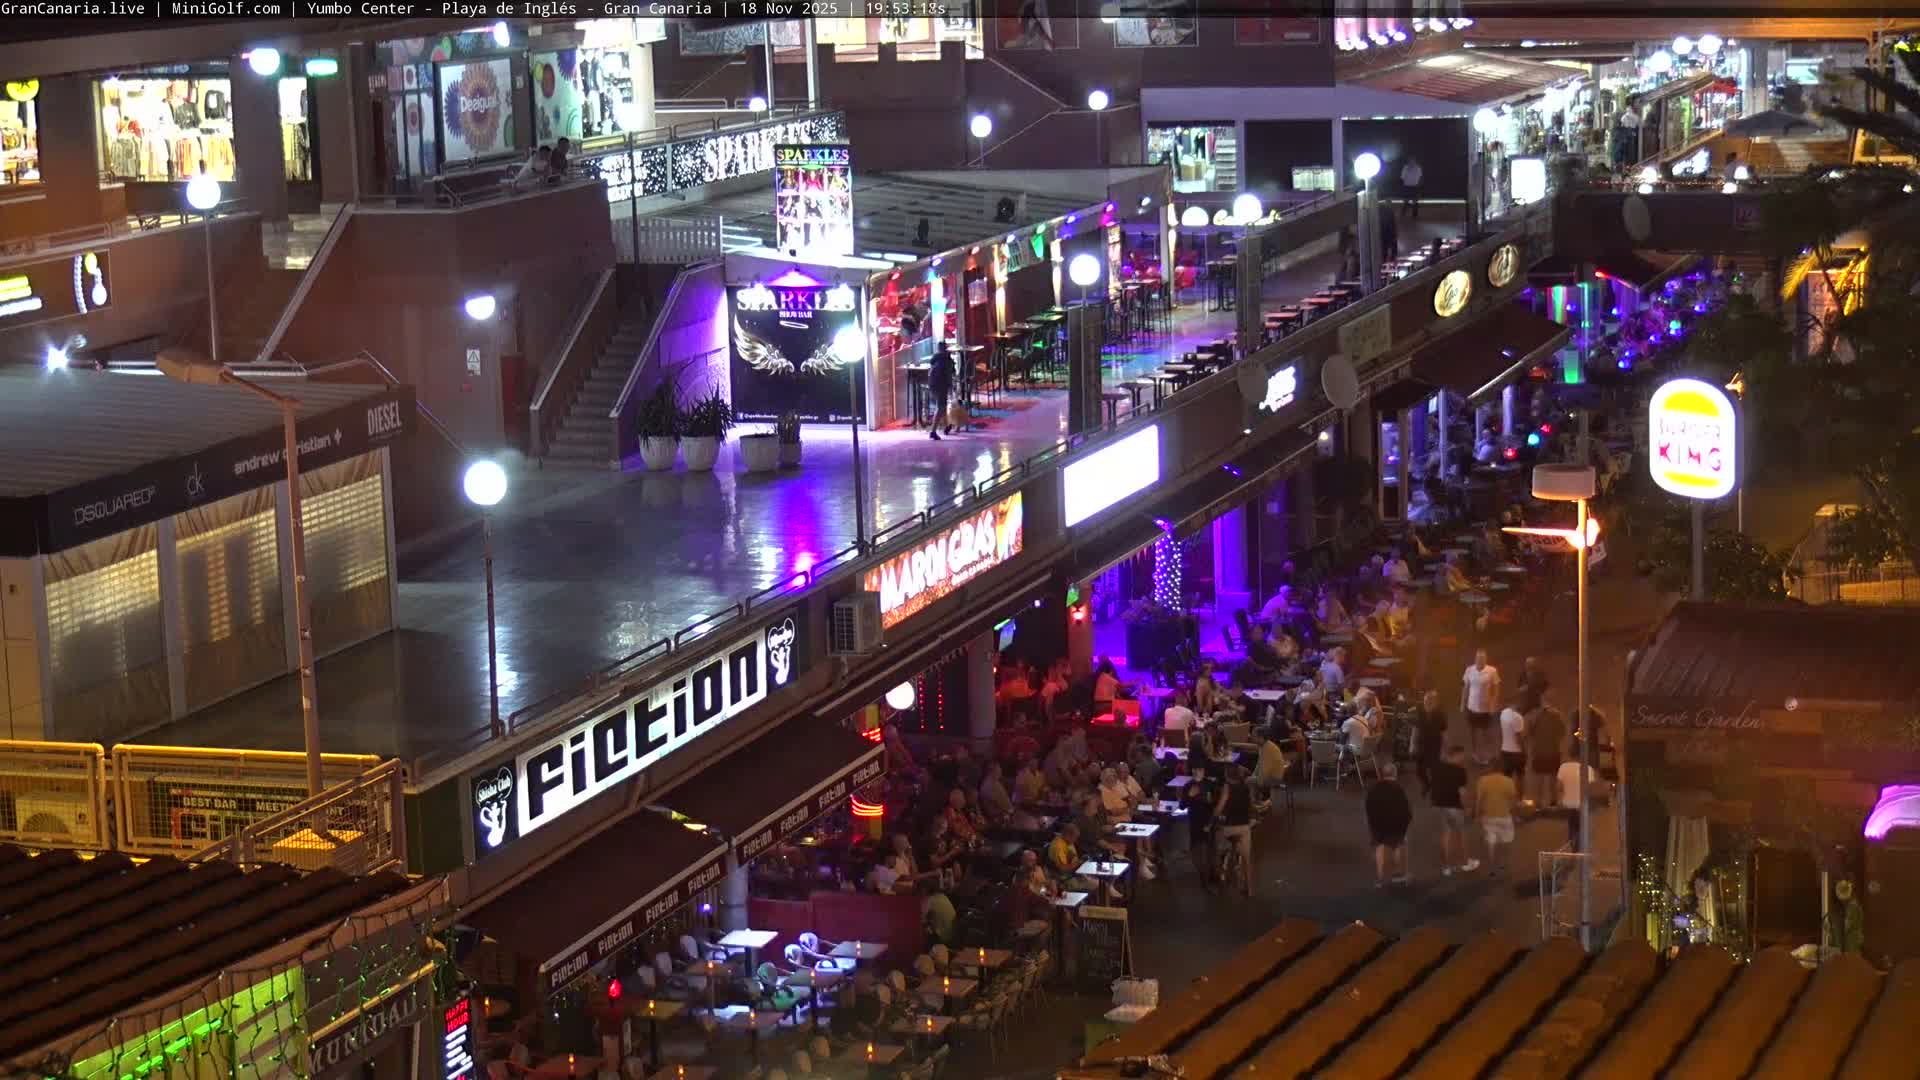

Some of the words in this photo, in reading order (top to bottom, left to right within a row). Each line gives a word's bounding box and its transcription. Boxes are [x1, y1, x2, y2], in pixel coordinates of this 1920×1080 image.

[776, 149, 850, 161] SPARKLES
[799, 311, 813, 319] BAR
[367, 400, 403, 436] DIESEL
[234, 449, 280, 476] andrew
[282, 433, 332, 460] cristian
[1657, 440, 1723, 472] KING
[187, 461, 205, 496] ck
[879, 537, 947, 614] MARDI
[948, 509, 997, 573] GRAS
[478, 783, 498, 802] Shisha
[497, 775, 511, 792] Club
[183, 797, 213, 808] BEST
[214, 799, 237, 810] BAR
[445, 998, 469, 1020] HAPPY
[447, 1011, 469, 1033] HOUR
